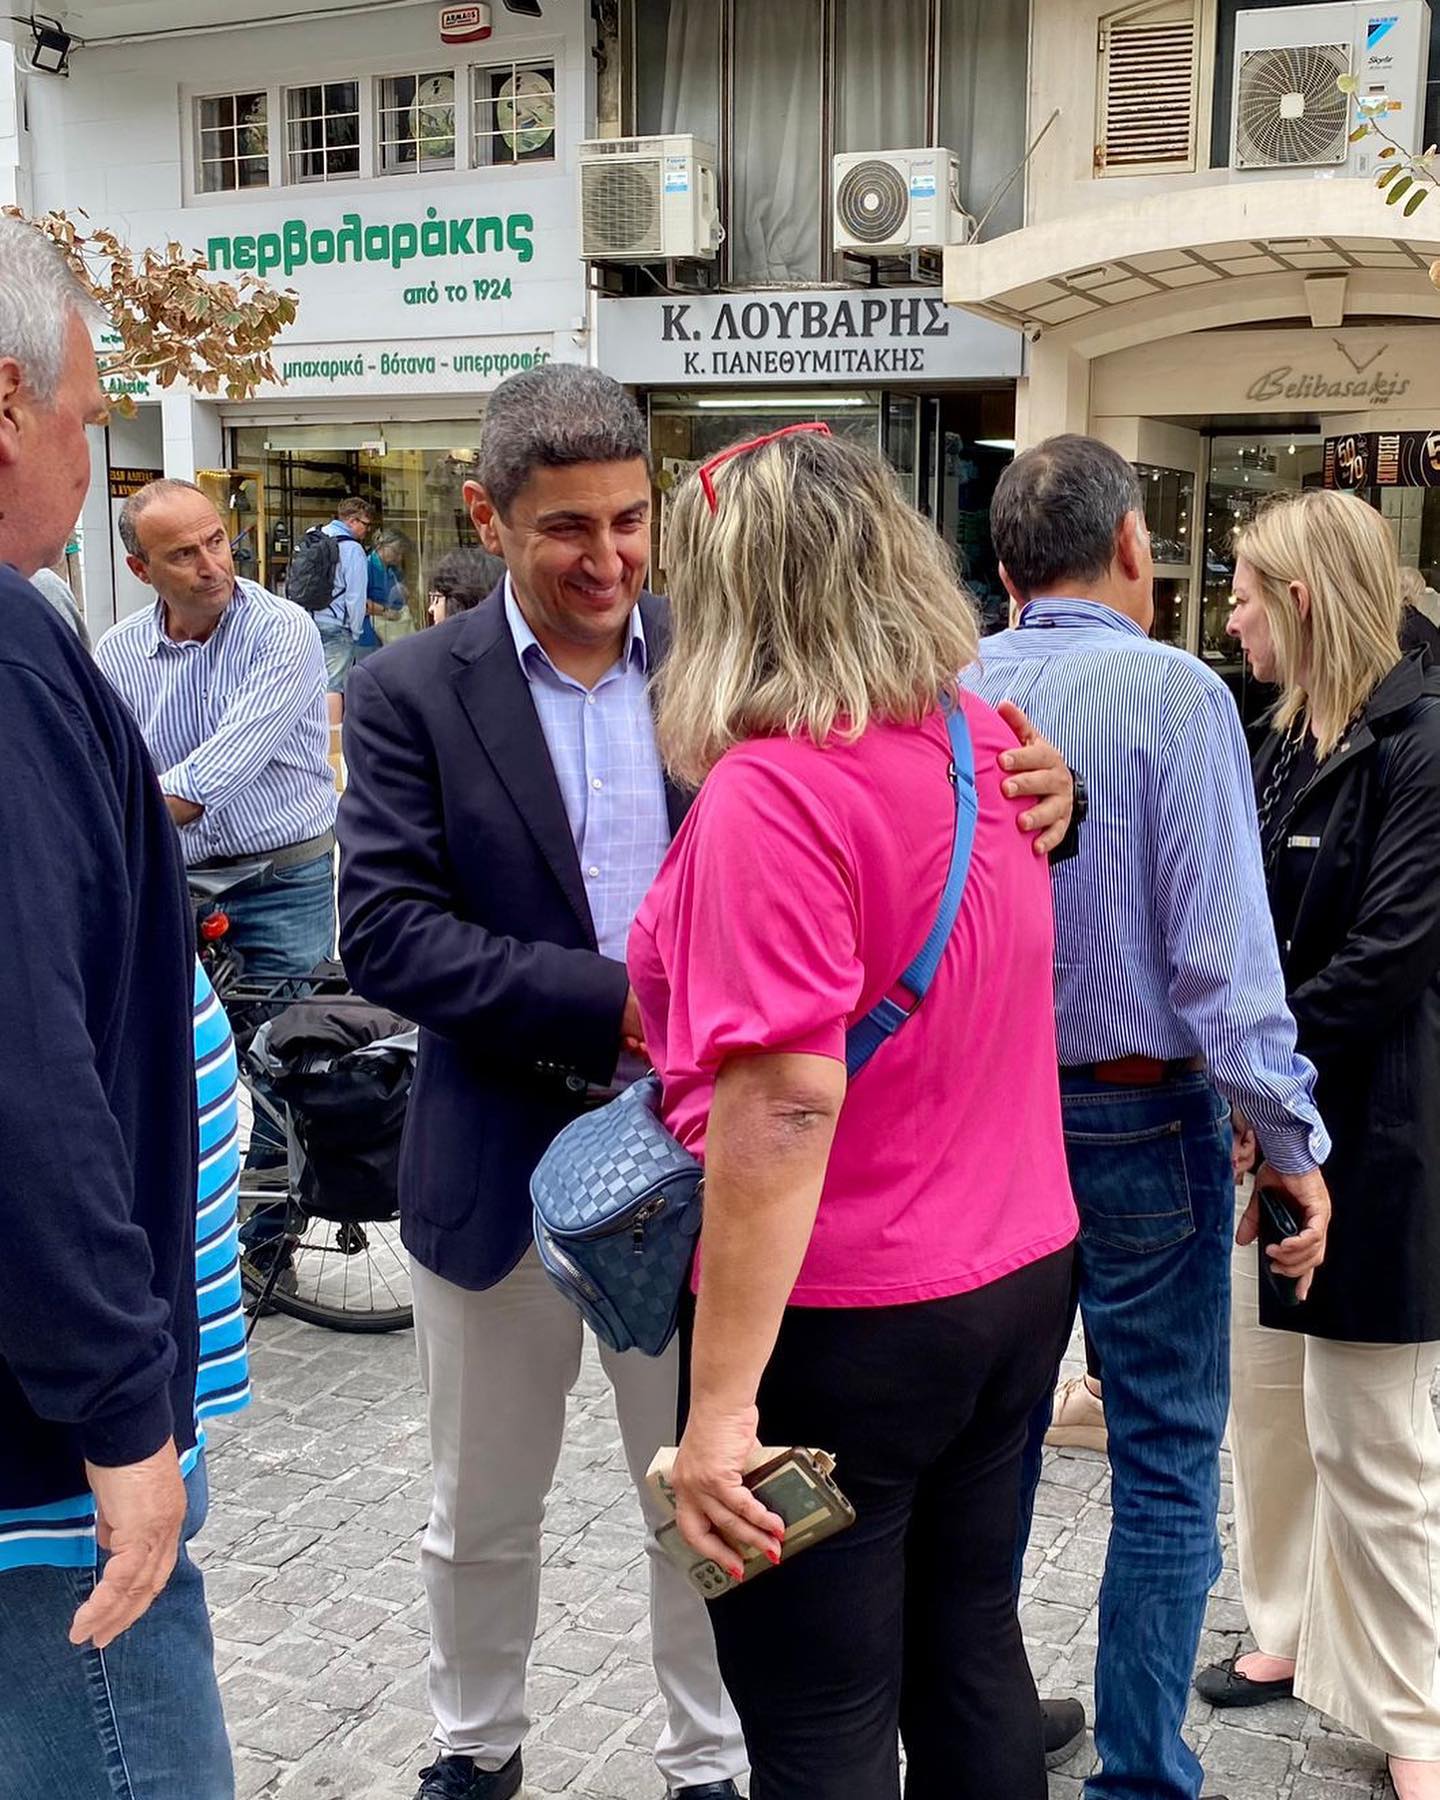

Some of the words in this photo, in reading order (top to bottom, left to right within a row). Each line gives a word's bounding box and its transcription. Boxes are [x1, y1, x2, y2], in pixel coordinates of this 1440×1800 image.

[207, 206, 533, 277] περβολαράκης
[403, 281, 437, 305] από
[444, 285, 467, 303] το
[473, 278, 512, 300] 1924
[661, 305, 701, 341] Κ.
[711, 298, 949, 340] ΛΟΥΒΑΡΗΣ
[283, 354, 364, 381] μπαχαρικά
[683, 352, 706, 374] Κ.
[712, 348, 924, 374] ΠΑΝΕΘΥΜΙΤΑΚΗΣ
[1246, 366, 1411, 401] Belibasakis
